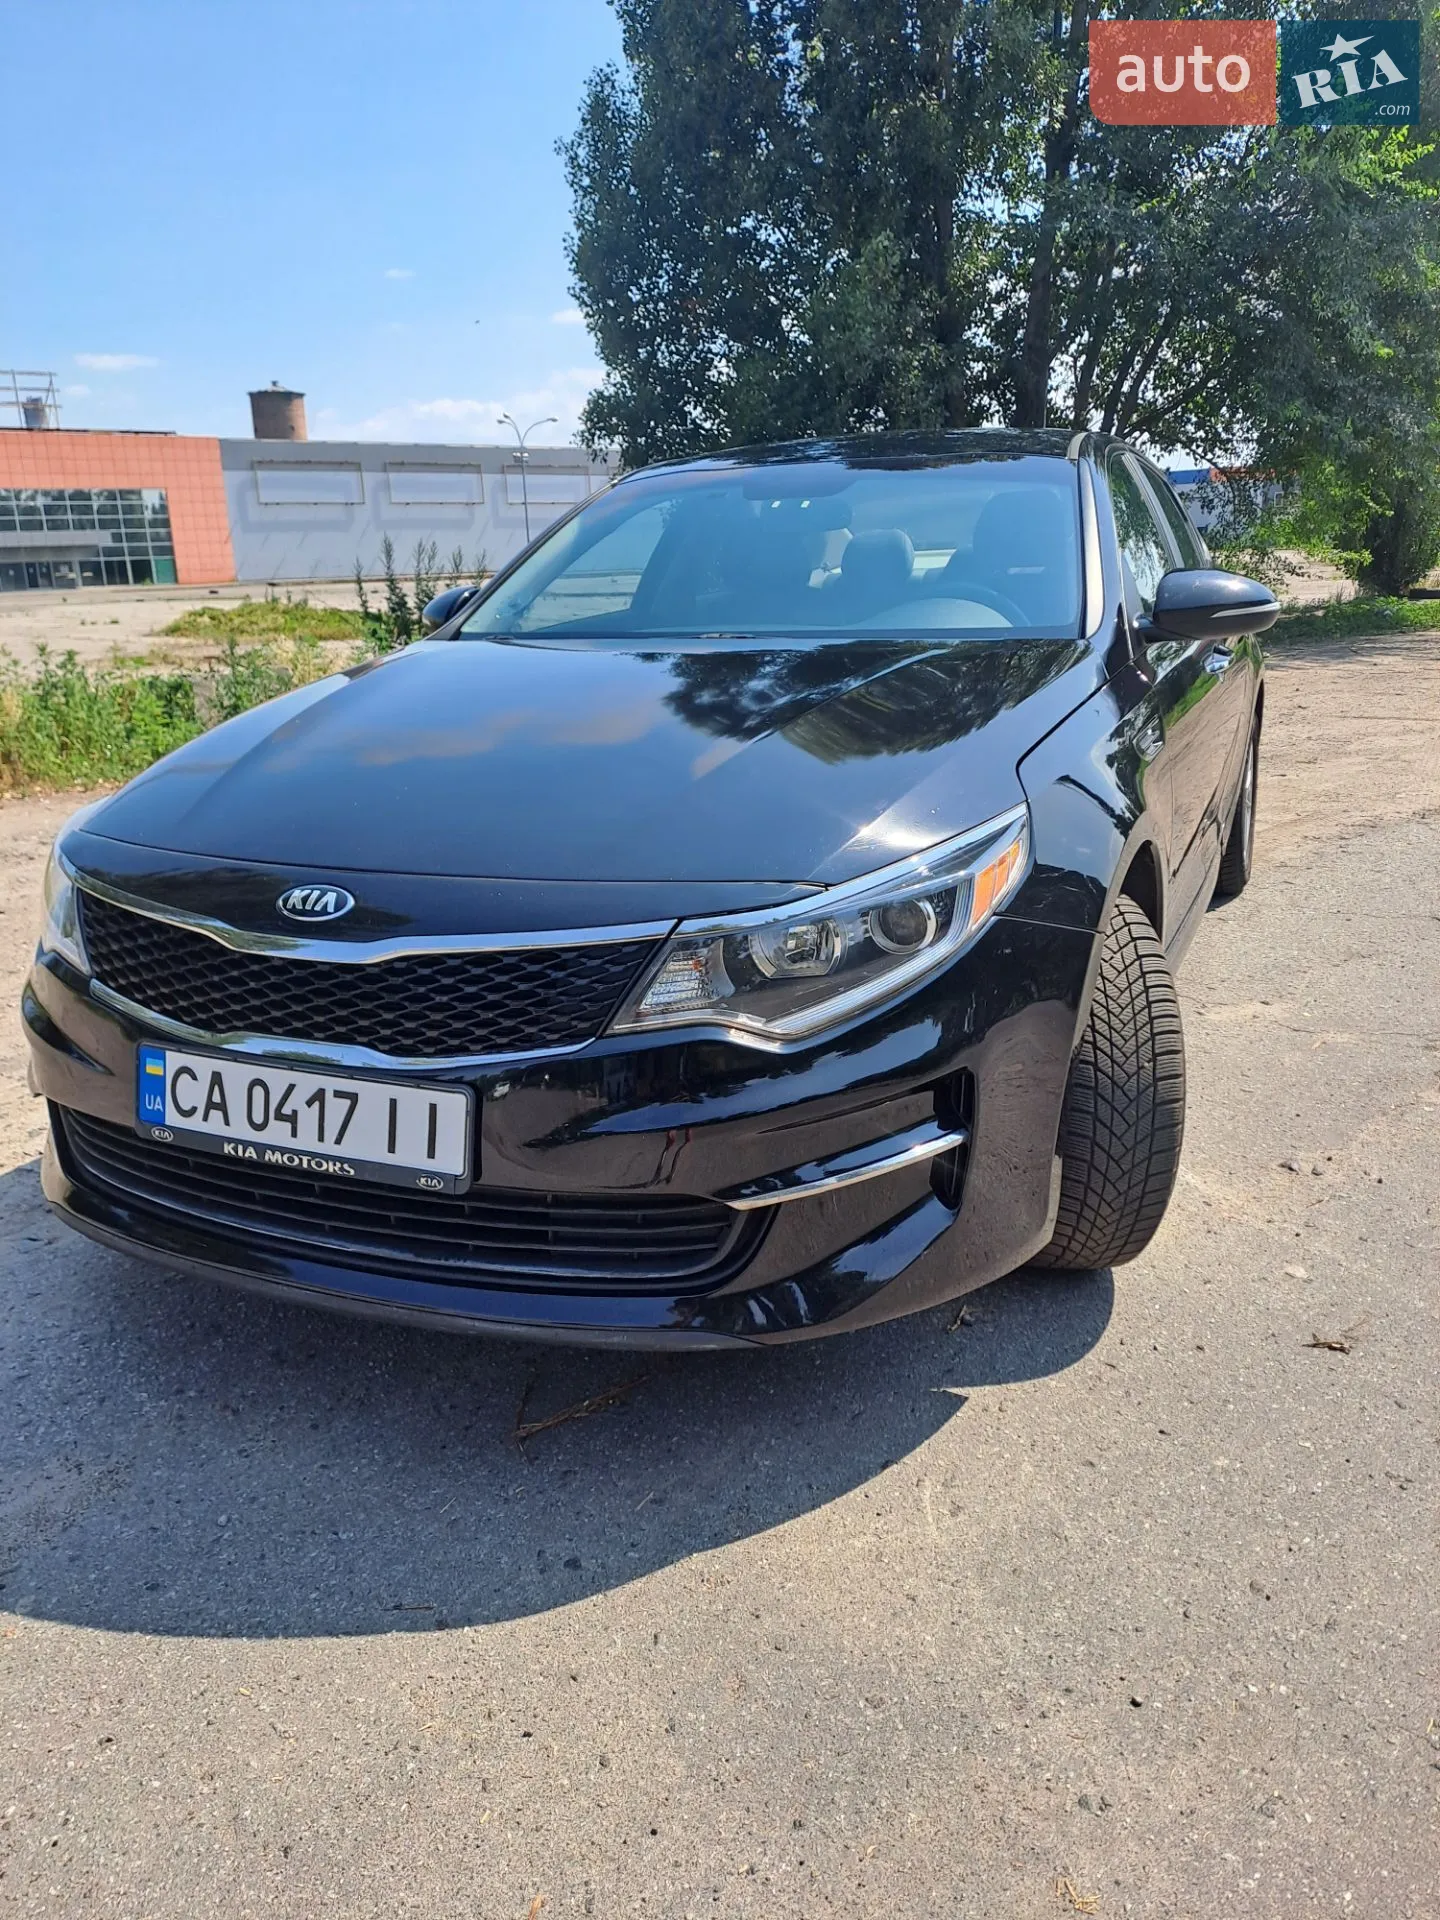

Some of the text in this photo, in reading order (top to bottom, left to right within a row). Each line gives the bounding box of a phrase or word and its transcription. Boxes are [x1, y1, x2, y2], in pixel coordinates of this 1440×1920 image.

[286, 889, 337, 913] KIA
[145, 1093, 164, 1113] UA
[170, 1065, 231, 1127] CA
[246, 1077, 360, 1146] 0417
[154, 1130, 170, 1139] KIA
[223, 1141, 356, 1176] KIA MOTORS
[420, 1176, 440, 1188] KIA
